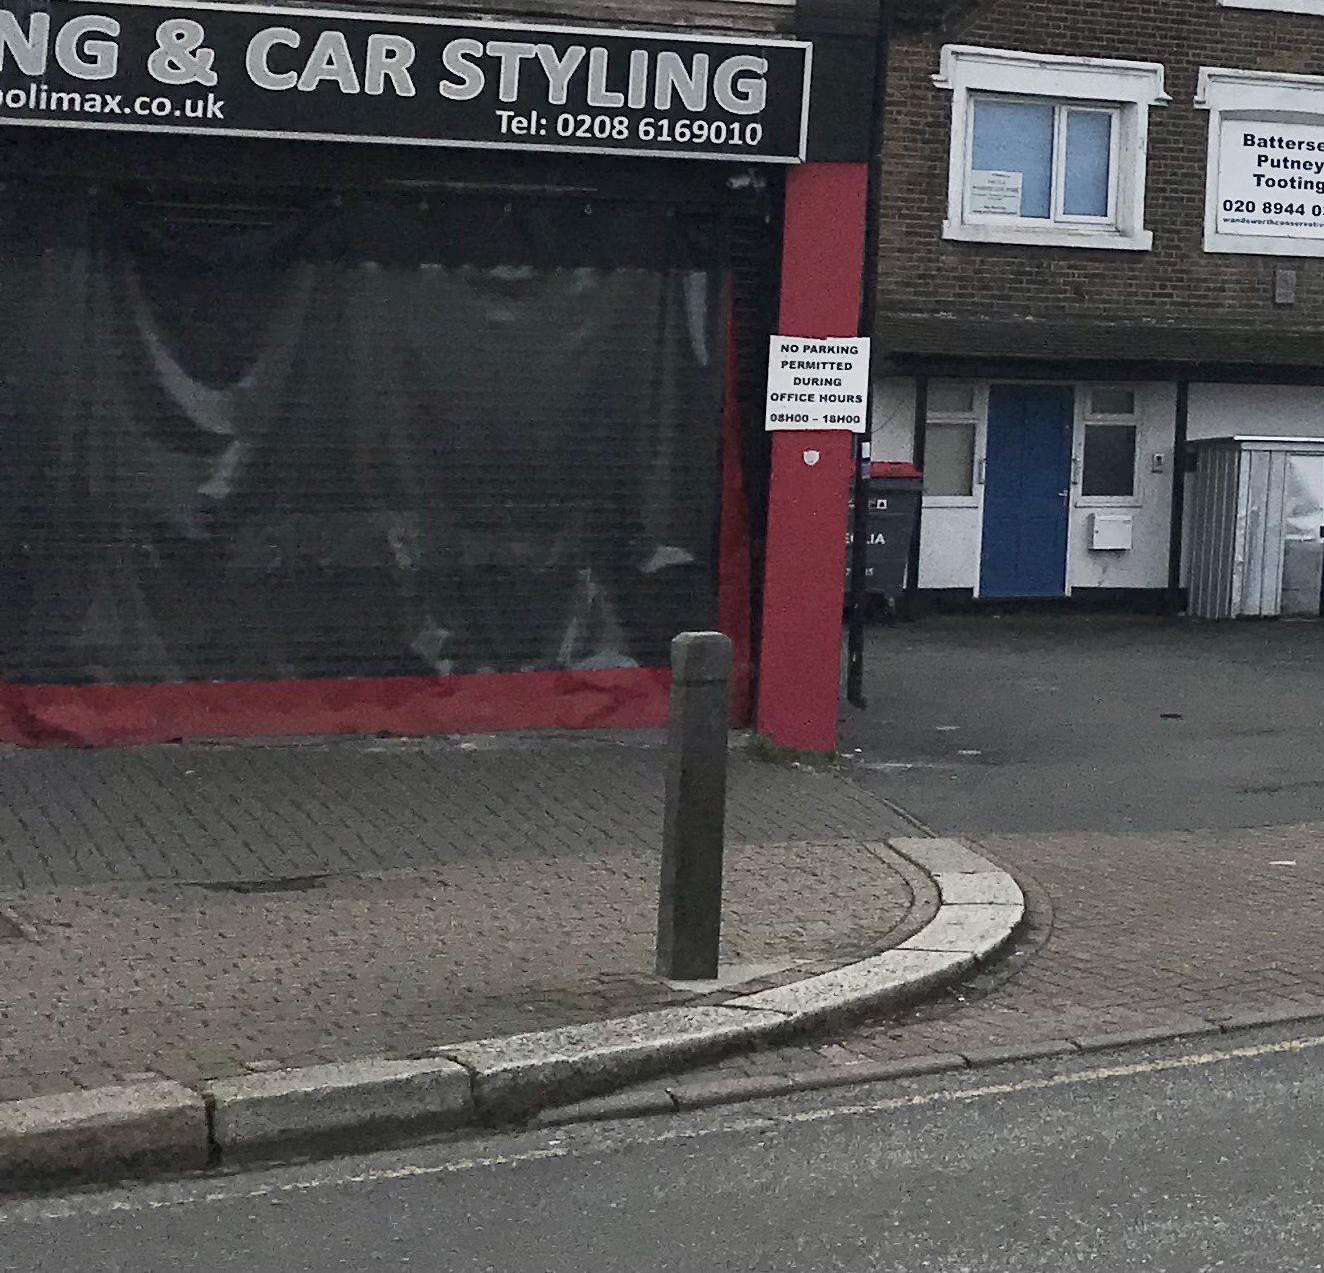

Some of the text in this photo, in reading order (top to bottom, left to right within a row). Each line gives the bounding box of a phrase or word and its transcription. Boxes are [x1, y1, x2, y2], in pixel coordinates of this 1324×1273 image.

[147, 18, 218, 87] &
[245, 26, 417, 98] CAR
[438, 37, 769, 115] STYLING
[496, 110, 763, 147] Tel: 0208 6169010
[1257, 154, 1324, 175] Putney
[1223, 199, 1256, 213] 020
[1262, 202, 1305, 216] 8944
[780, 344, 859, 355] NO PARKING
[781, 360, 853, 371] PERMITTED
[793, 377, 842, 387] DURING
[770, 393, 863, 403] OFFICE HOURS
[770, 414, 809, 423] 08H00
[822, 414, 860, 424] 18H00
